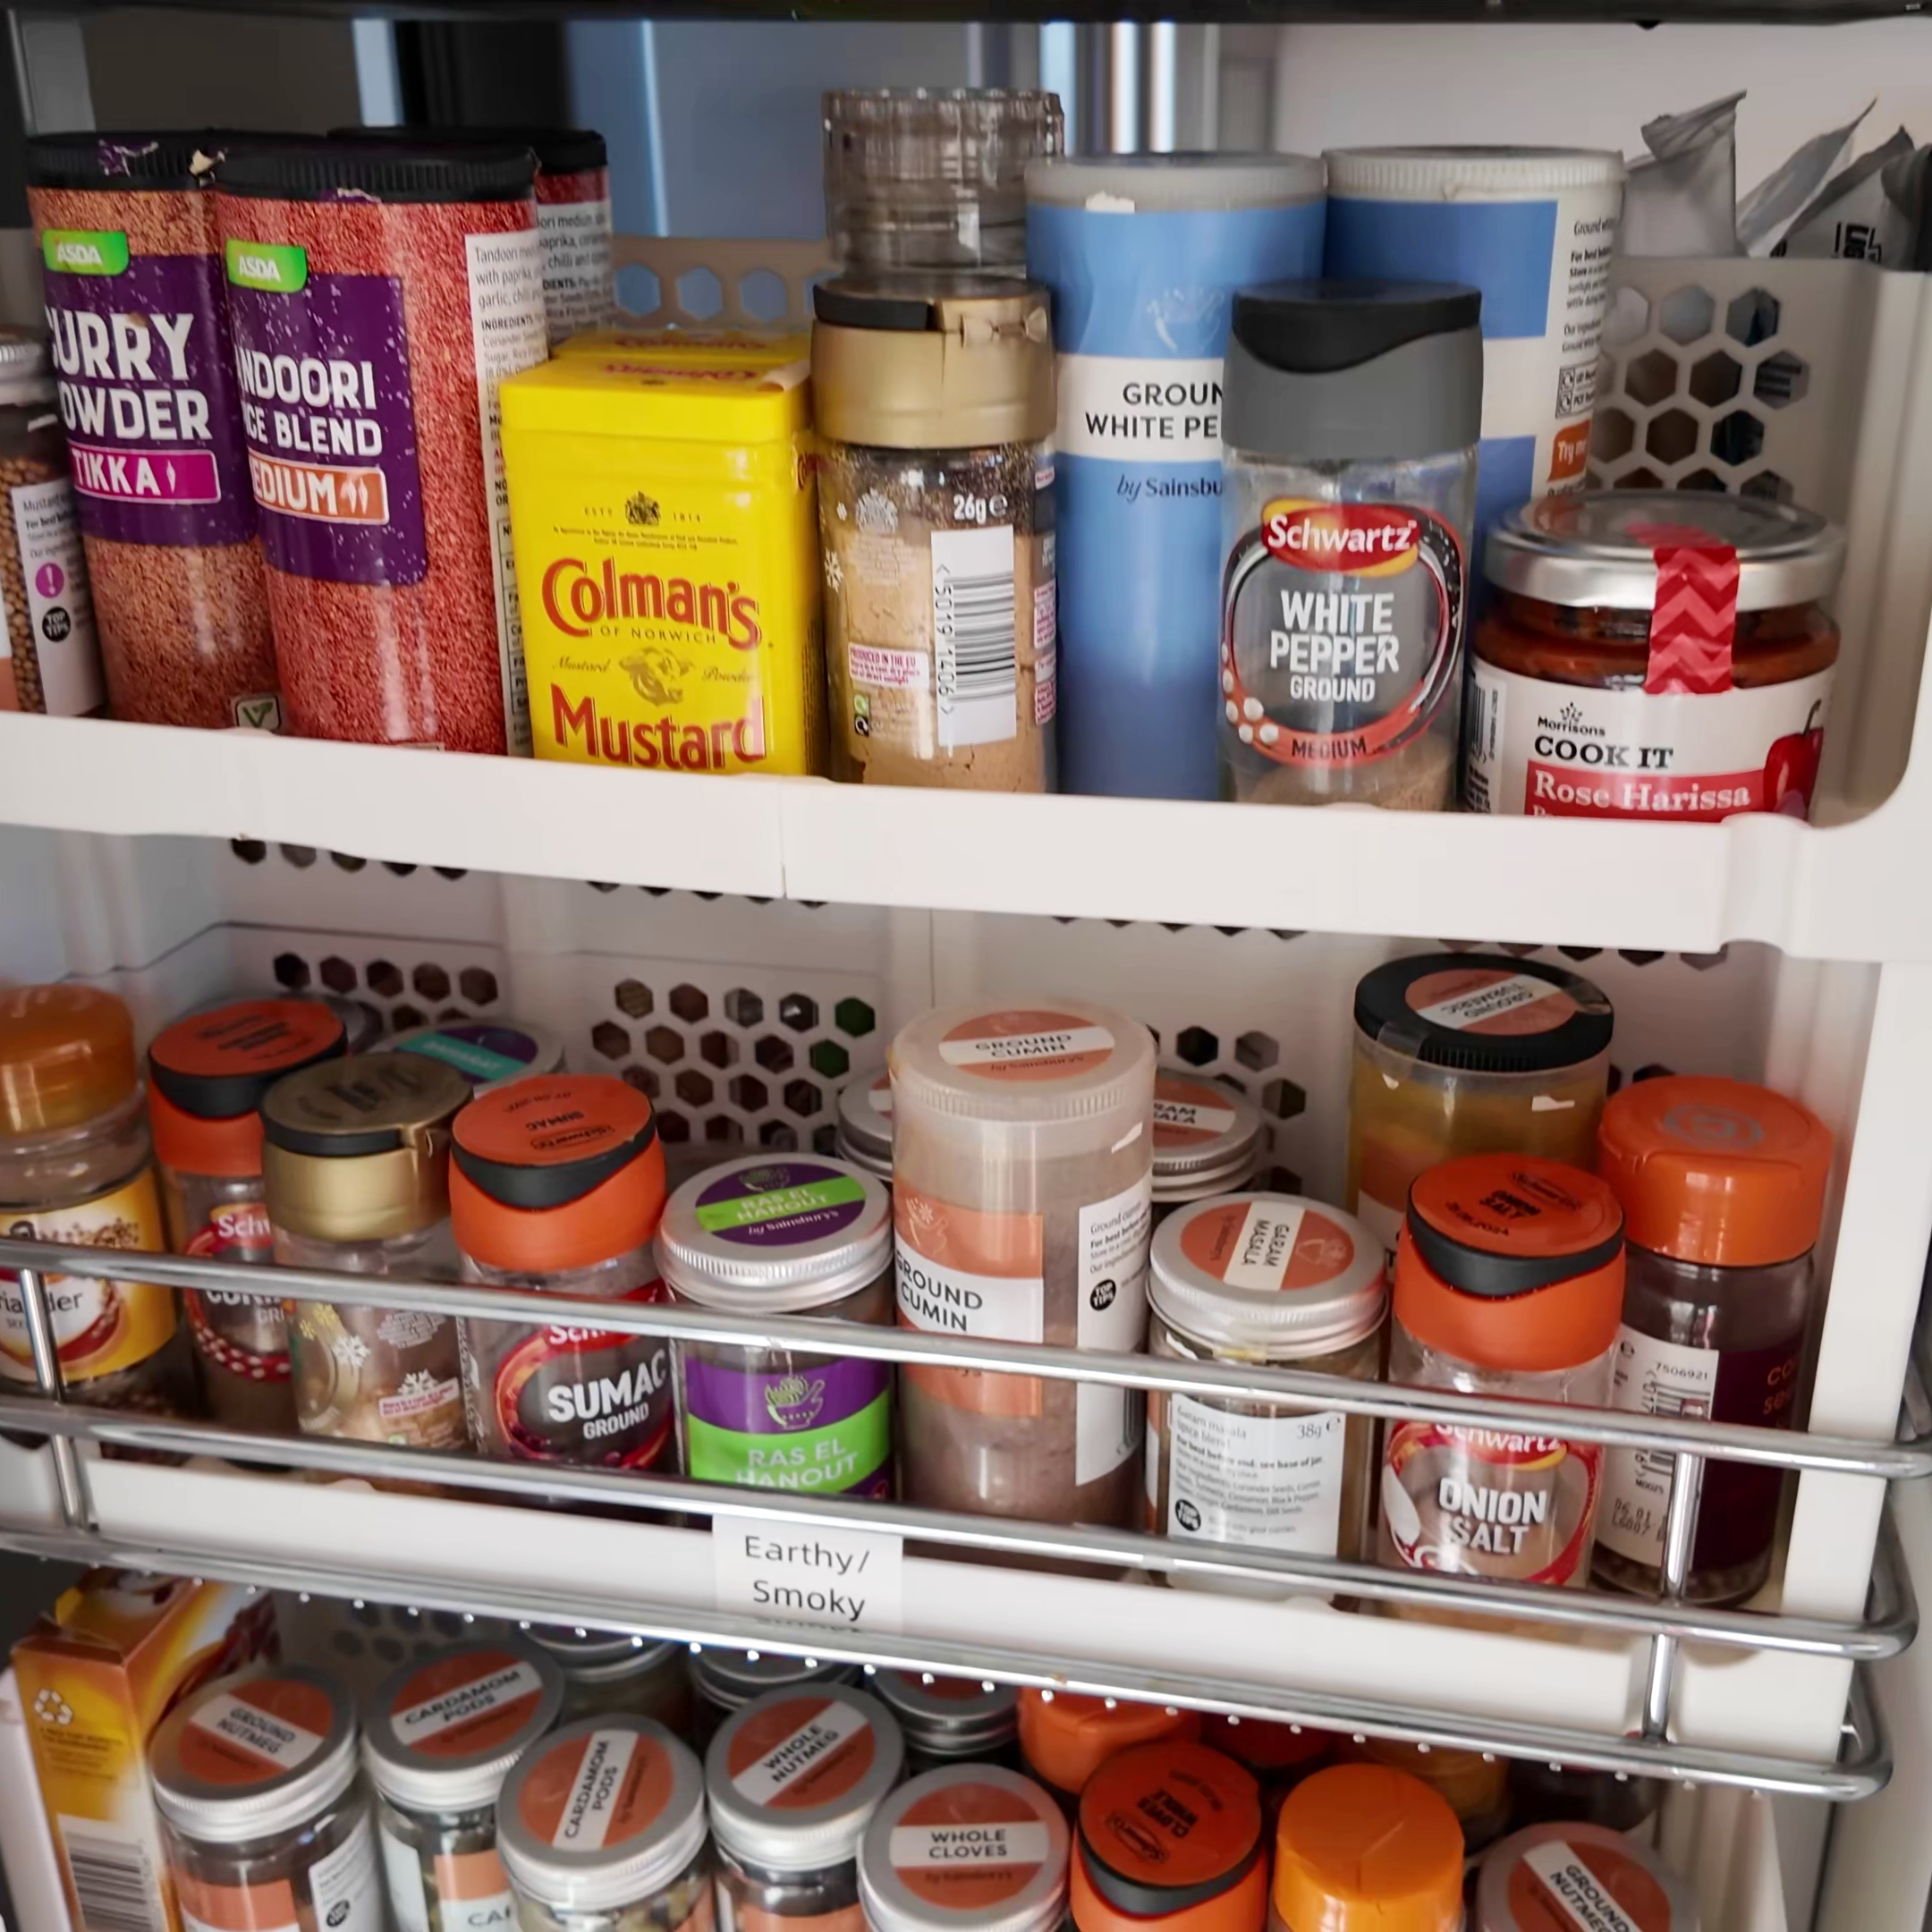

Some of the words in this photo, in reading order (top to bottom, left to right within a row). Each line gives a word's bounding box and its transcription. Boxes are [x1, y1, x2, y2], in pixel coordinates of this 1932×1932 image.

[57, 243, 102, 266] ASDA
[238, 256, 281, 281] ASDA
[60, 380, 213, 440] OWDER
[1123, 383, 1224, 405] GROUN
[274, 411, 382, 456] BLEND
[1085, 412, 1174, 439] WHITE
[71, 448, 161, 496] TIKKA
[250, 459, 338, 516] EDIUM
[1117, 475, 1142, 504] by
[1146, 478, 1223, 498] Sainsbu
[1267, 513, 1413, 553] Schwartz
[542, 555, 762, 650] Colman's
[1281, 589, 1395, 633] WHITE
[600, 624, 620, 636] OF
[631, 628, 716, 645] NORWICH
[1271, 630, 1400, 675] PEPPER
[1290, 678, 1376, 703] GROUND
[551, 682, 766, 769] Mustard
[1538, 716, 1606, 736] Morrisons
[1292, 739, 1368, 759] MEDIUM
[1535, 735, 1630, 767] COOK
[1637, 746, 1674, 768] IT
[1534, 769, 1611, 808] Rose
[1620, 782, 1750, 812] Harissa
[975, 1033, 1072, 1051] GROUND
[991, 1043, 1065, 1058] CUMIN
[736, 1194, 828, 1221] HANOUT
[741, 1193, 784, 1212] RAS
[767, 1209, 840, 1231] Sainsbury's
[1091, 1212, 1121, 1234] Ground
[896, 1250, 983, 1310] GROUND
[901, 1280, 967, 1332] CUMIN
[547, 1348, 666, 1422] SUMAC
[1656, 1362, 1708, 1381] 7506921
[583, 1402, 649, 1440] GROUND
[1296, 1422, 1322, 1440] 38g
[735, 1452, 859, 1489] HANOUT
[748, 1446, 806, 1467] RAS
[815, 1437, 846, 1462] EL
[1439, 1477, 1547, 1525] ONION
[1450, 1516, 1530, 1555] SALT
[744, 1535, 870, 1576] Earthy/
[752, 1580, 866, 1623] Smoky
[404, 1670, 521, 1724] CARDAMOM
[443, 1693, 496, 1722] PODS
[216, 1718, 282, 1754] NUTMEG
[765, 1724, 824, 1771] WHOLE
[771, 1729, 840, 1784] NUTMEG
[564, 1740, 610, 1839] CARDAMOM
[594, 1766, 619, 1811] PODS
[928, 1843, 1007, 1860] CLOVES
[930, 1828, 1006, 1843] WHOLE
[1565, 1864, 1630, 1932] GROUND
